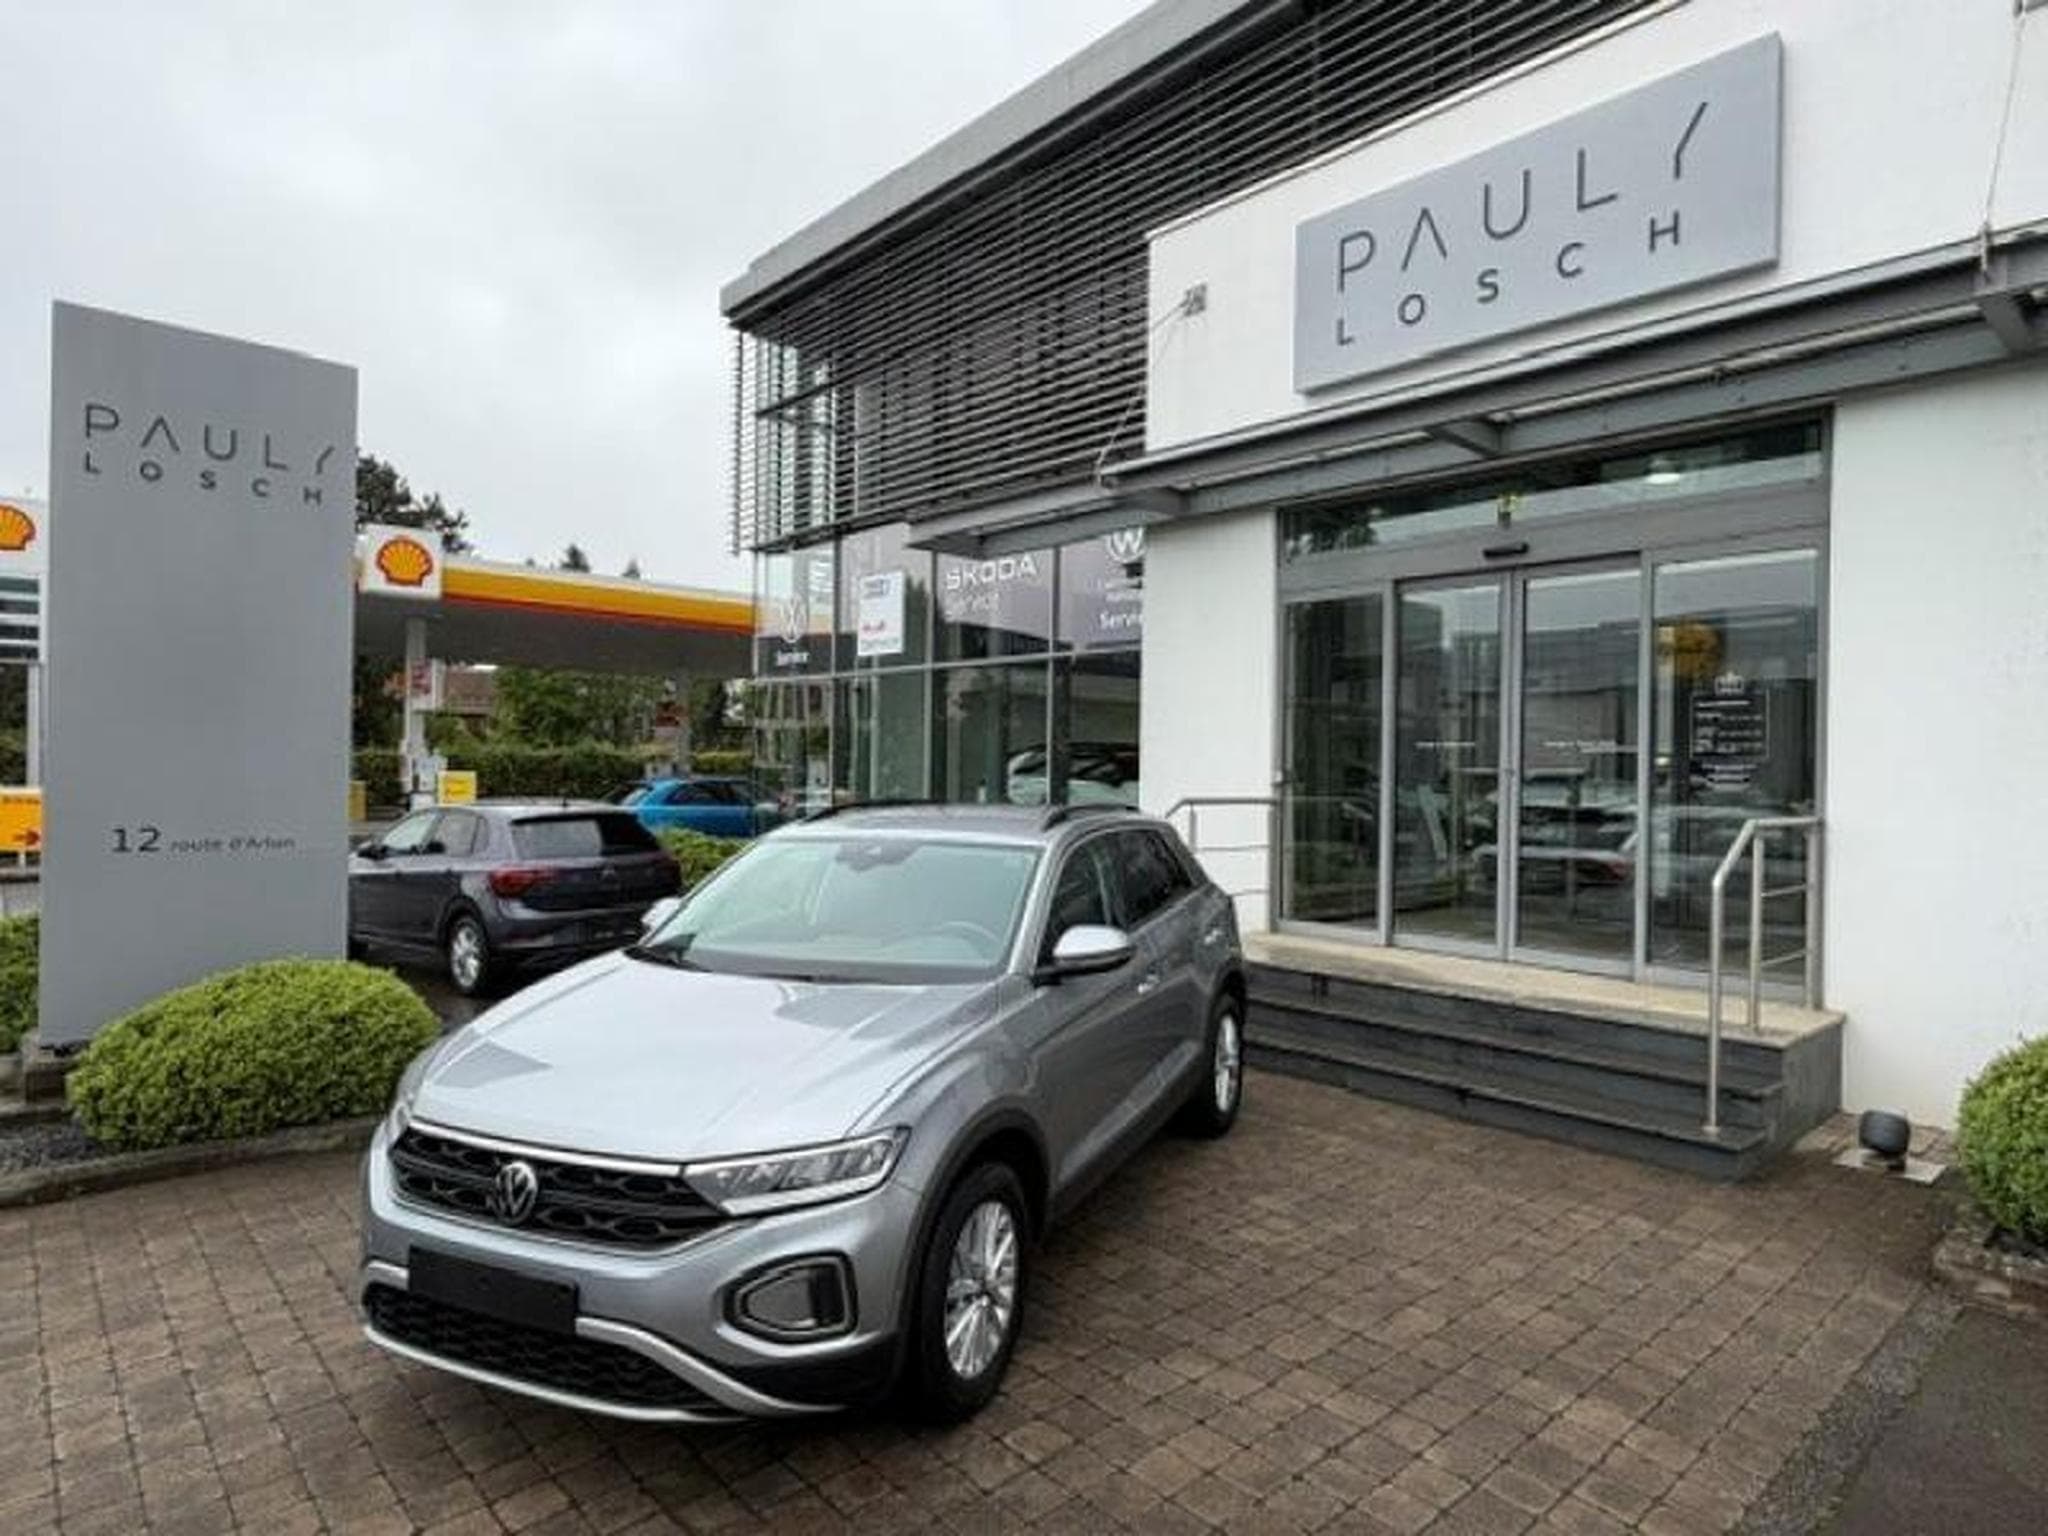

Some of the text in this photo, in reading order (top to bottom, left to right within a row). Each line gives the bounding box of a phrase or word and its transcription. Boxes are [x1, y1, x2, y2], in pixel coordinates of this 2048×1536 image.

[1340, 102, 1708, 293] PAULY
[1337, 211, 1681, 345] LOSCH
[84, 403, 335, 475] PAULY
[84, 451, 322, 505] LOSCH
[112, 827, 162, 852] 12
[171, 838, 223, 852] route
